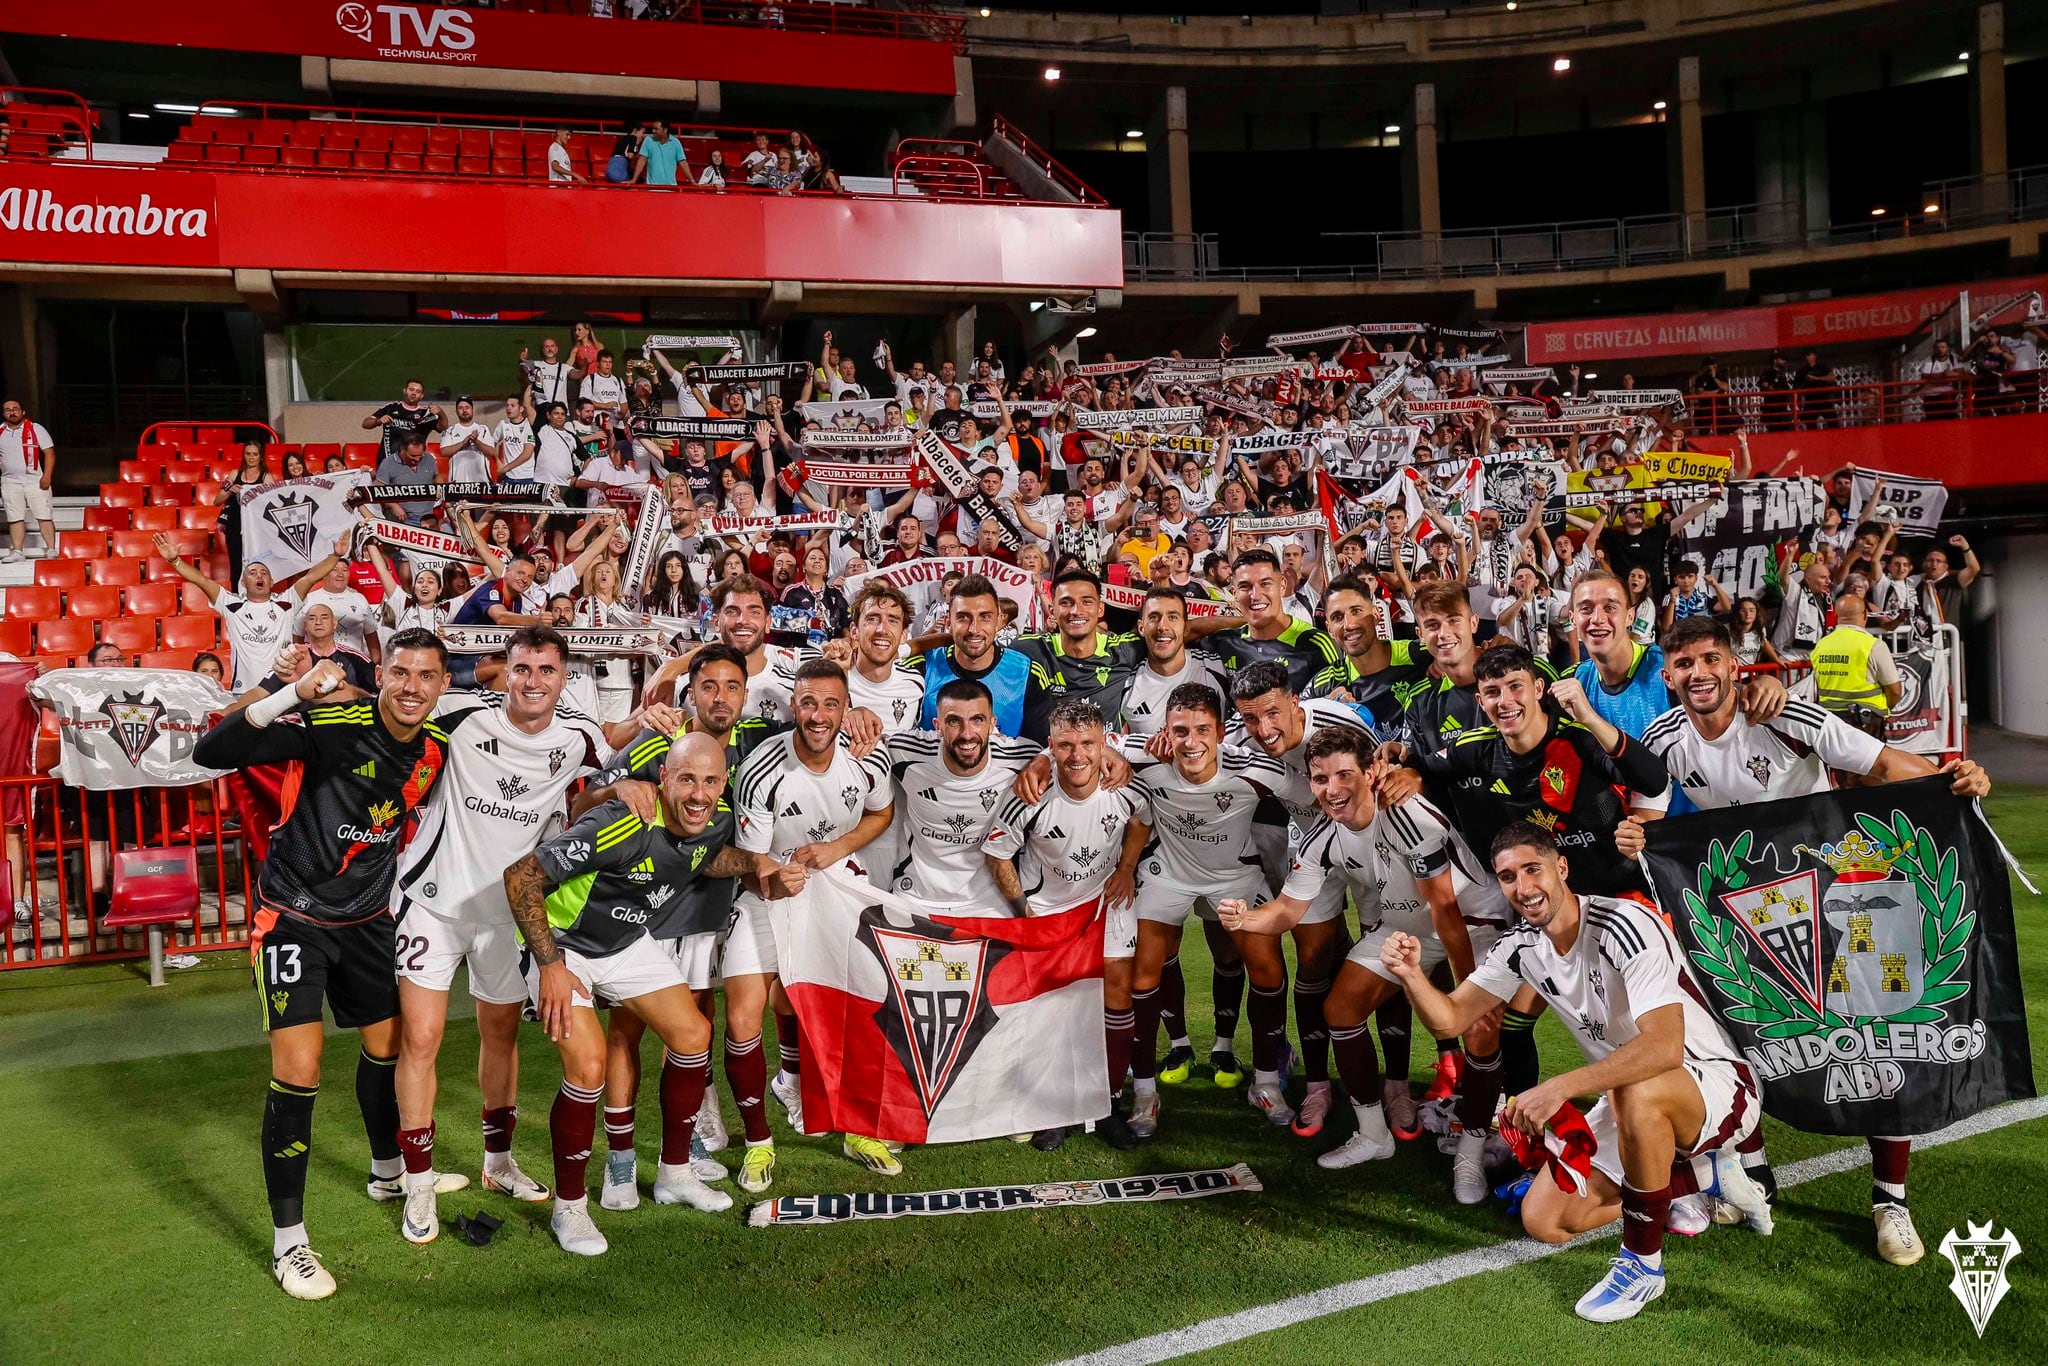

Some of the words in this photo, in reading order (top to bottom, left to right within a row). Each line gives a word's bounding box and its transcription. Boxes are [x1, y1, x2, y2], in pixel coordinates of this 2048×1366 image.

[377, 5, 476, 50] TVS
[377, 47, 478, 62] TECHVISUALSPORT
[0, 187, 208, 237] Alhambra
[1824, 305, 1913, 332] CERVEZAS
[1573, 327, 1652, 350] CERVEZAS
[1658, 322, 1747, 345] ALHAMBRA
[708, 369, 747, 380] ALBACETE
[747, 364, 786, 378] BALOMPIÉ
[1318, 369, 1354, 378] ALBA
[1076, 411, 1129, 427] CURVA
[1135, 406, 1201, 422] ROMMEL
[1408, 400, 1449, 412] ALBACETE
[655, 420, 699, 434] ALBACETE
[812, 434, 857, 443] ALBACETE
[918, 431, 965, 488] Albacete
[1666, 456, 1729, 481] Chospes
[809, 468, 848, 479] LOCURA
[848, 470, 868, 479] POR
[869, 470, 881, 479] EL
[881, 471, 908, 480] ALBA
[374, 486, 428, 498] ALBACETE
[711, 514, 774, 532] QUIJOTE
[779, 509, 838, 525] BLANCO
[377, 522, 441, 549] ALBACETE
[631, 543, 648, 592] ALBACETE
[465, 796, 540, 827] Globalcaja
[1159, 817, 1229, 846] Globalcaja
[1380, 899, 1421, 914] alcaja
[265, 943, 302, 984] 13
[394, 934, 430, 971] 22
[1744, 1018, 1988, 1083] ANDOLEROS
[1823, 1059, 1906, 1105] ABP
[776, 1186, 1035, 1223] SQUADRA
[1104, 1171, 1229, 1201] 1940
